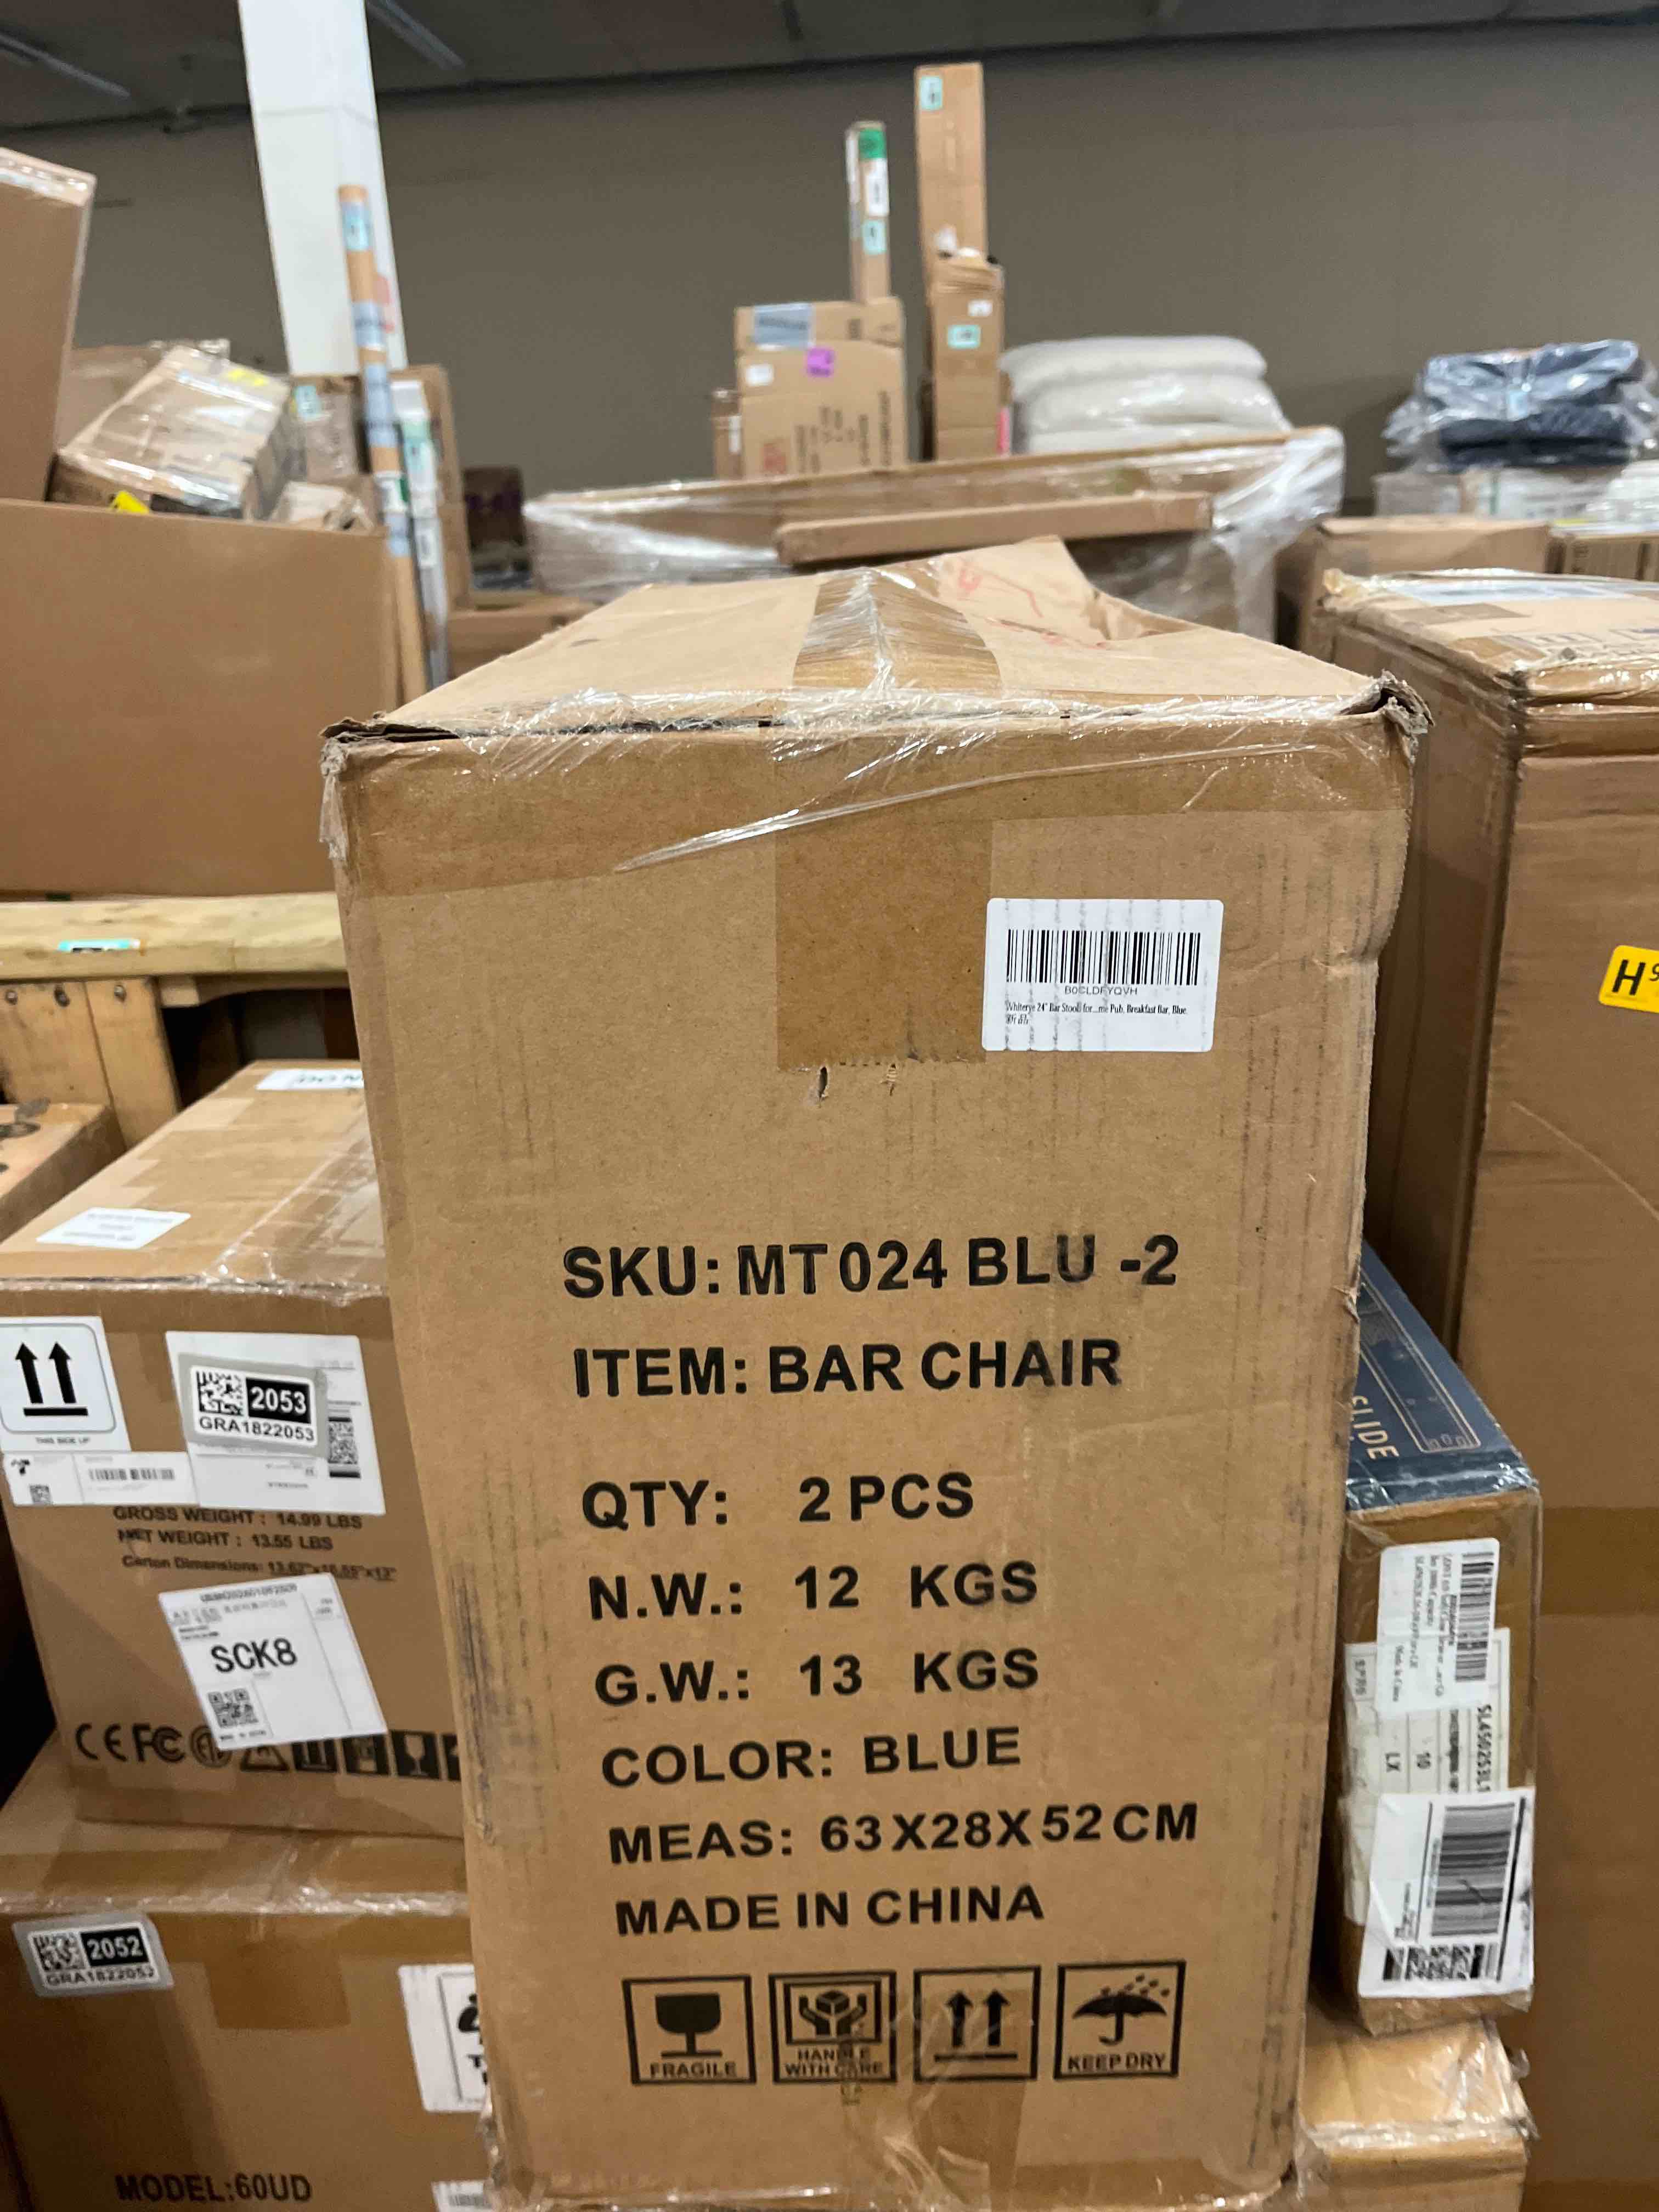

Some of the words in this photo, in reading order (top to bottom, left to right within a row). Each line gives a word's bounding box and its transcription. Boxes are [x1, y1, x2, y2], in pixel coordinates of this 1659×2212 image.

[1612, 958, 1646, 996] H
[1049, 1002, 1061, 1012] Bar
[1127, 1004, 1156, 1014] Breakfast
[563, 1245, 720, 1299] SKU:
[968, 1234, 1096, 1286] BLU
[1120, 1234, 1180, 1286] -2
[573, 1347, 748, 1398] ITEM:
[769, 1344, 904, 1394] BAR
[921, 1339, 1122, 1391] CHAIR
[251, 1386, 307, 1415] 2053
[199, 1416, 315, 1442] GRA1822053
[112, 1505, 178, 1521] GROSS
[183, 1507, 255, 1523] WEIGHT
[325, 1515, 363, 1530] LBS
[582, 1480, 728, 1531] QTY:
[799, 1476, 831, 1522] 2
[850, 1471, 974, 1522] PCS
[157, 1530, 230, 1546] WEIGHT
[298, 1536, 334, 1550] LBS
[589, 1572, 742, 1621] N.W.:
[795, 1565, 859, 1610] 12
[911, 1560, 1037, 1610] KGS
[211, 1637, 298, 1673] SCK8
[595, 1660, 749, 1708] G.W.:
[799, 1654, 862, 1697] 13
[914, 1647, 1039, 1694] KGS
[602, 1740, 832, 1788] COLOR:
[864, 1726, 1021, 1775] BLUE
[609, 1819, 793, 1865] MEAS:
[616, 1894, 780, 1936] MADE
[797, 1891, 849, 1929] IN
[867, 1883, 1045, 1926] CHINA
[86, 1934, 144, 1961] 2052
[649, 2061, 737, 2079] FRAGILE
[785, 2061, 831, 2078] WITH
[1068, 2053, 1121, 2072] KEEP
[1125, 2051, 1166, 2068] DRY
[114, 2172, 314, 2202] MODEL:60UD
